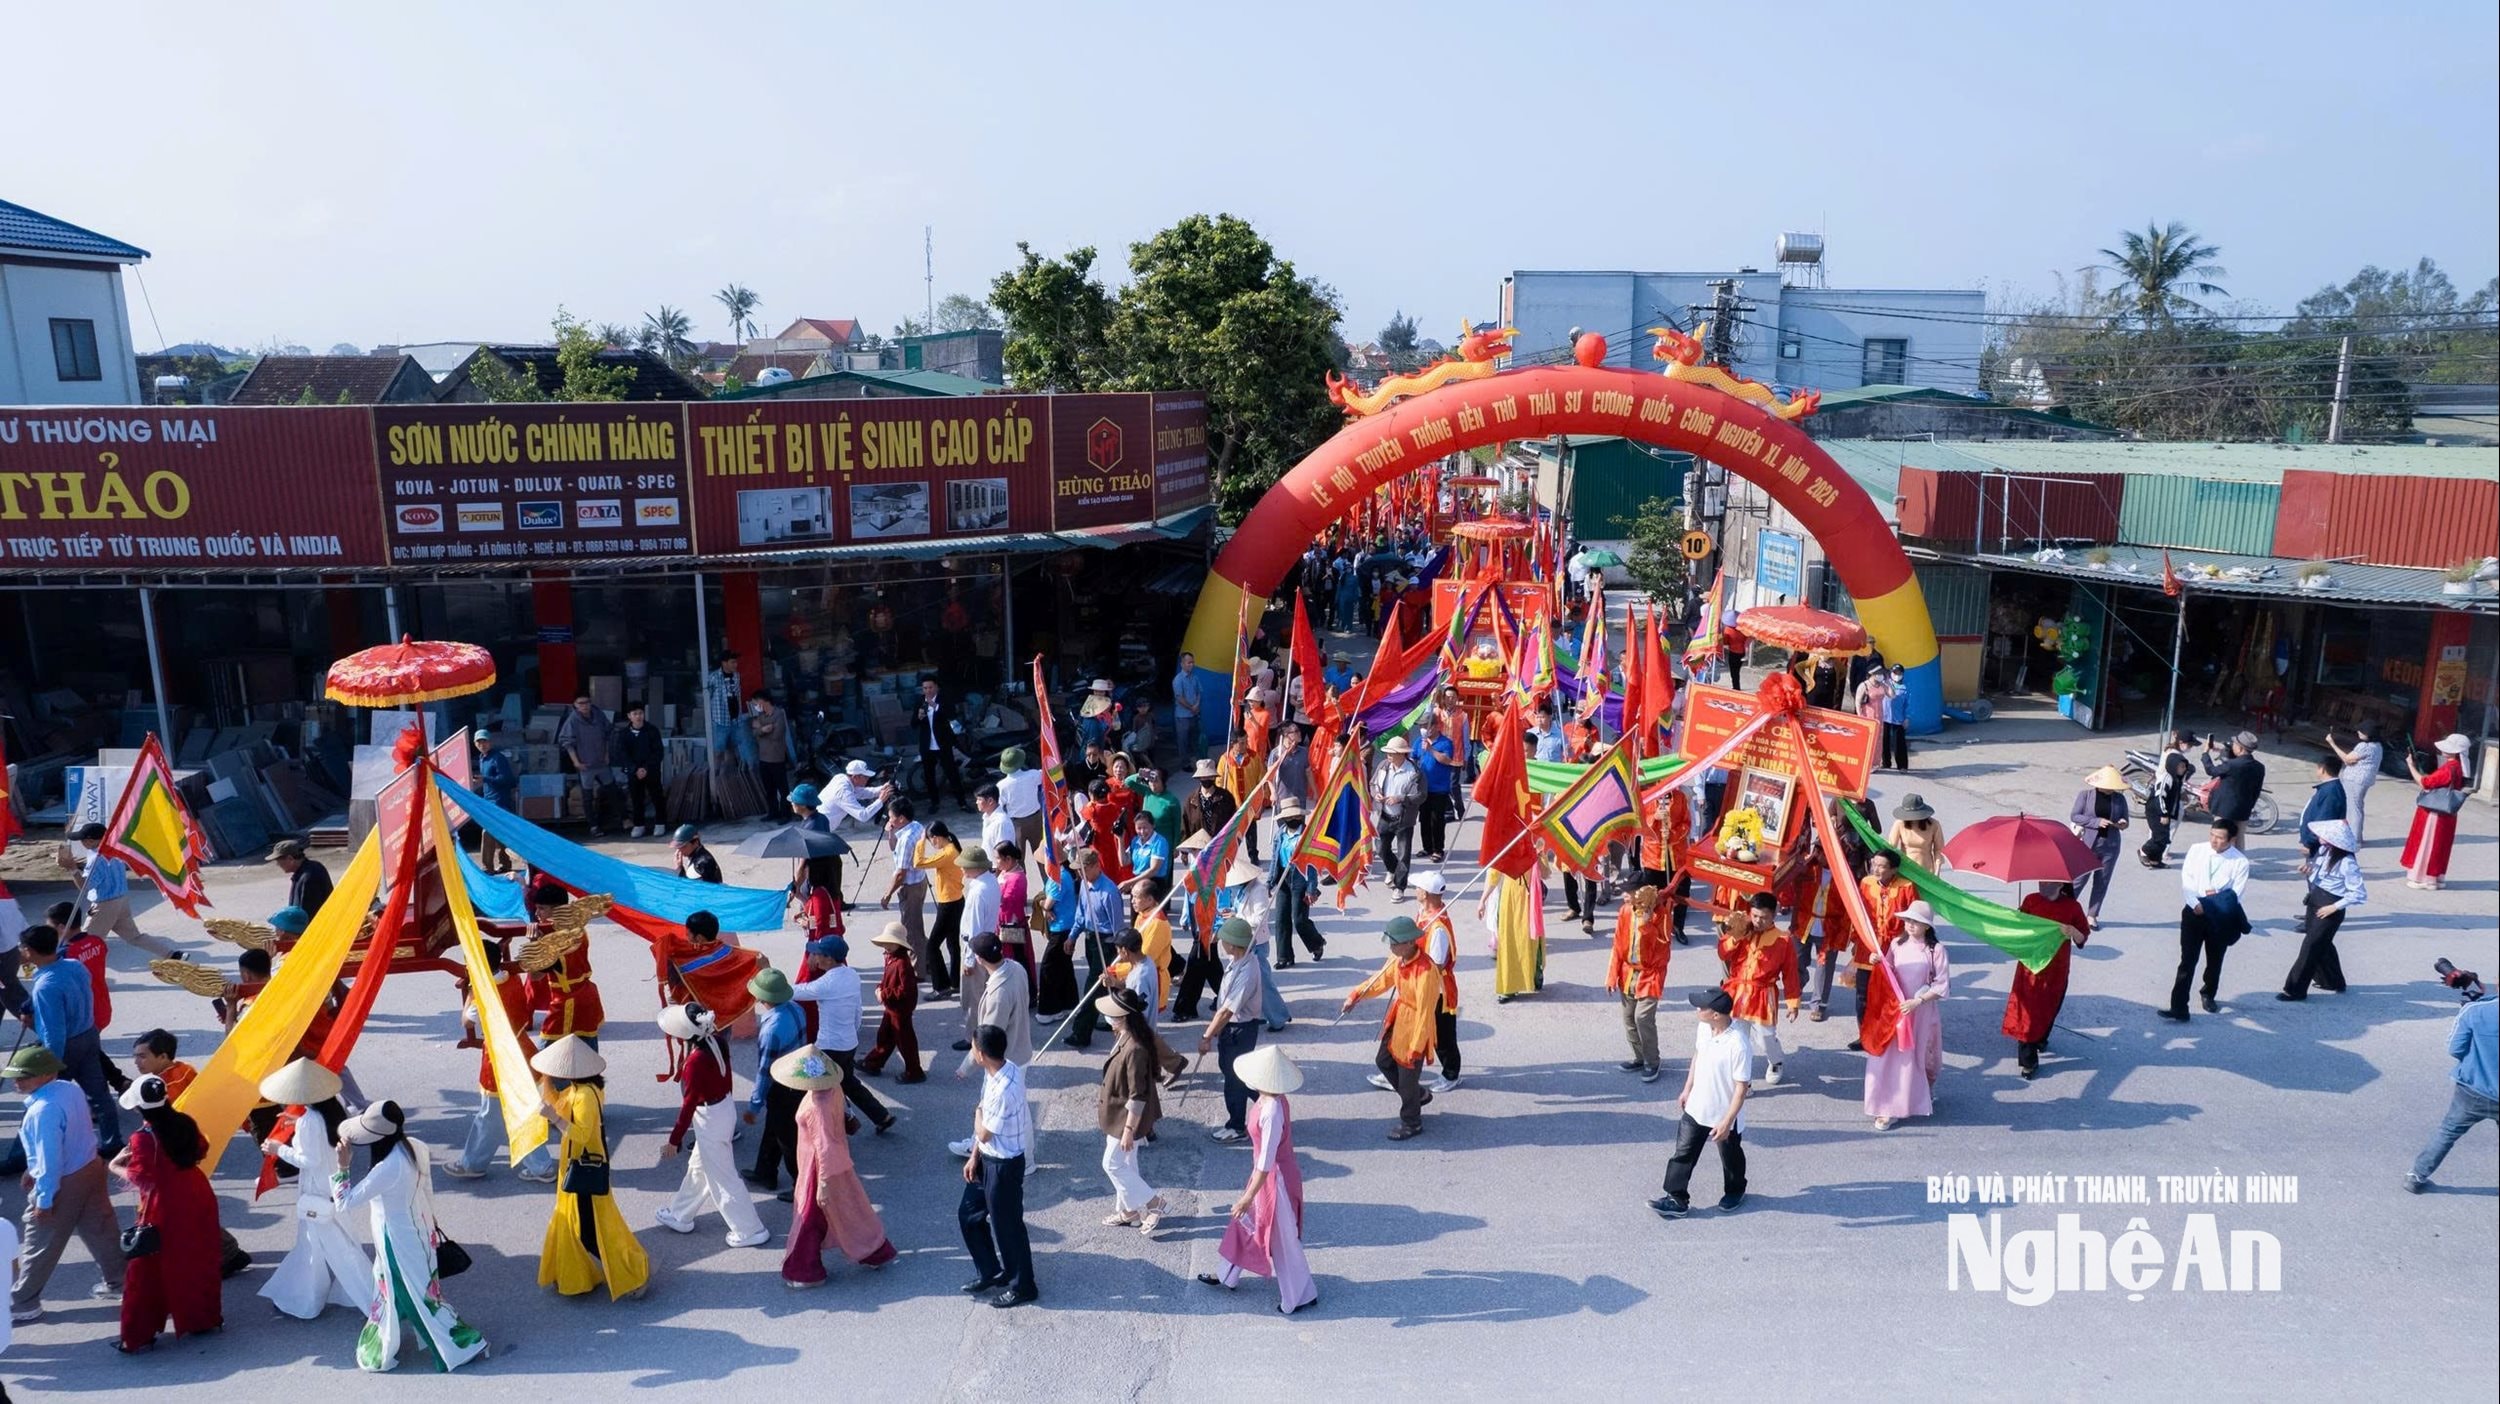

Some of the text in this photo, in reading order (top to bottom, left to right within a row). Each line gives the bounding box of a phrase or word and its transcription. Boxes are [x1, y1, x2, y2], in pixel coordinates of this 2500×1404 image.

[26, 416, 152, 443] THƯƠNG
[161, 419, 217, 448] MẠI
[388, 415, 675, 465] SƠN NƯỚC CHÍNH HÃNG
[700, 401, 1033, 483] THIẾT BỊ VỆ SINH CAO CẤP
[1311, 480, 1333, 508] LỄ
[1330, 465, 1357, 493] HỘI
[1355, 437, 1405, 475] TRUYỀN
[1409, 416, 1453, 449] THỐNG
[1458, 401, 1485, 433] ĐỀN
[1491, 394, 1517, 423] THỜ
[1528, 388, 1556, 415] THÁI
[1565, 389, 1583, 413] SƯ
[1592, 390, 1634, 417] CƯƠNG
[1639, 394, 1674, 425] QUỐC
[1680, 406, 1714, 436] CÔNG
[1715, 421, 1765, 457] NGUYỄN
[1779, 454, 1810, 485] NĂM
[1806, 476, 1839, 508] 2026
[0, 451, 190, 520] THẢO
[395, 480, 434, 495] KOVA
[450, 478, 499, 494] JOTUN
[514, 477, 562, 492] DULUX
[578, 475, 622, 491] QUATA
[637, 474, 675, 489] SPEC
[1058, 474, 1104, 496] HÙNG
[1109, 469, 1151, 490] THẢO
[404, 511, 435, 521] KOVA
[470, 513, 500, 522] JOTUN
[523, 516, 553, 525] Dulux
[644, 507, 672, 517] SPEC
[7, 536, 59, 561] TRỰC
[62, 532, 103, 557] TIẾP
[108, 535, 135, 557] TỪ
[137, 537, 200, 556] TRUNG
[205, 530, 256, 557] QUỐC
[258, 532, 286, 556] VÀ
[289, 535, 342, 555] INDIA
[87, 781, 98, 822] GWAY
[79, 945, 101, 961] MUAY
